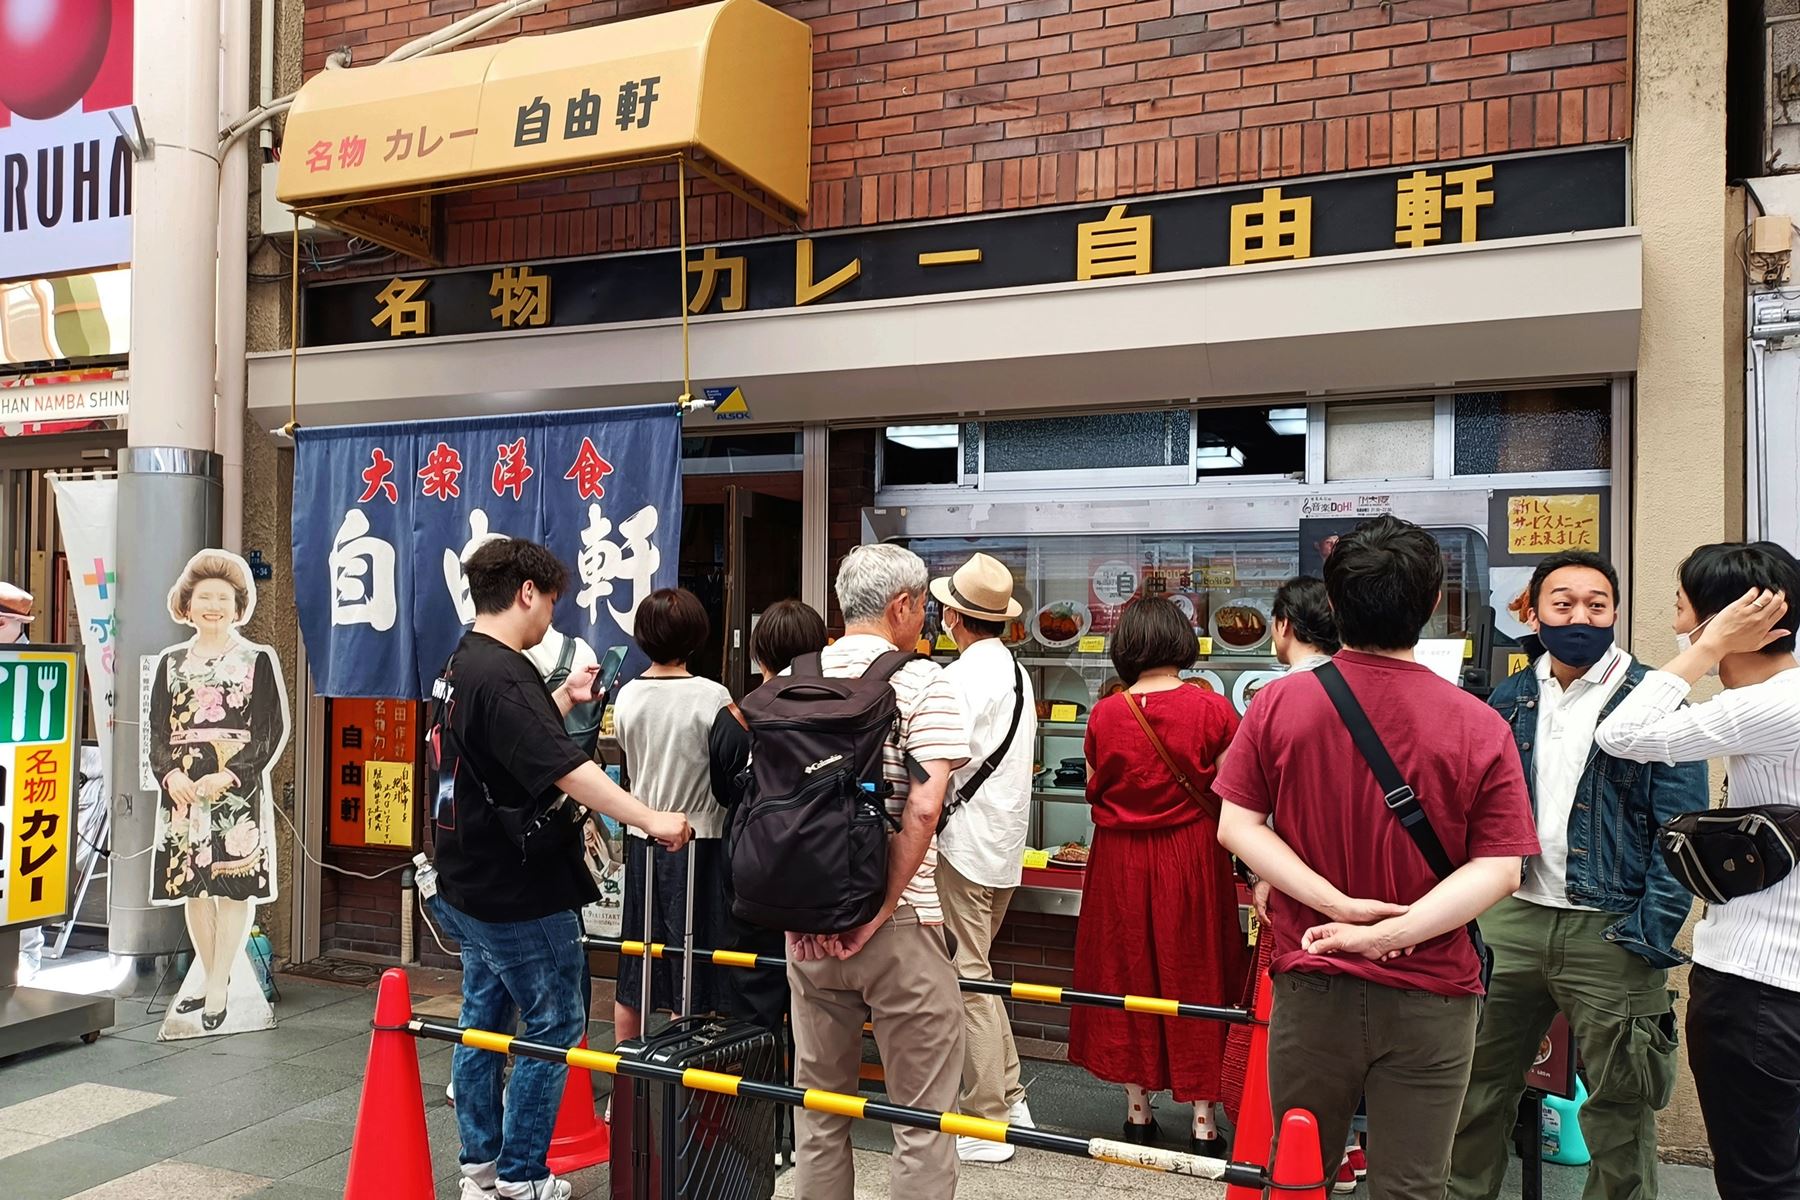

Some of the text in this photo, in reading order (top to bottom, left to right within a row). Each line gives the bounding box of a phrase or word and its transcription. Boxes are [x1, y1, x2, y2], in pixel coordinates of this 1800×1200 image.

[305, 76, 661, 174] 名物 カレー 自由軒
[370, 164, 1495, 337] 名物 カレー 自由軒
[34, 392, 85, 412] NAMBA
[716, 412, 751, 420] ALSOK
[357, 436, 614, 504] 大衆洋食
[1513, 499, 1550, 515] 新しく
[1513, 515, 1593, 530] サービスメニュー
[1514, 530, 1591, 547] が出来ました
[341, 724, 363, 823] 自由軒
[18, 749, 61, 902] 名物カレー
